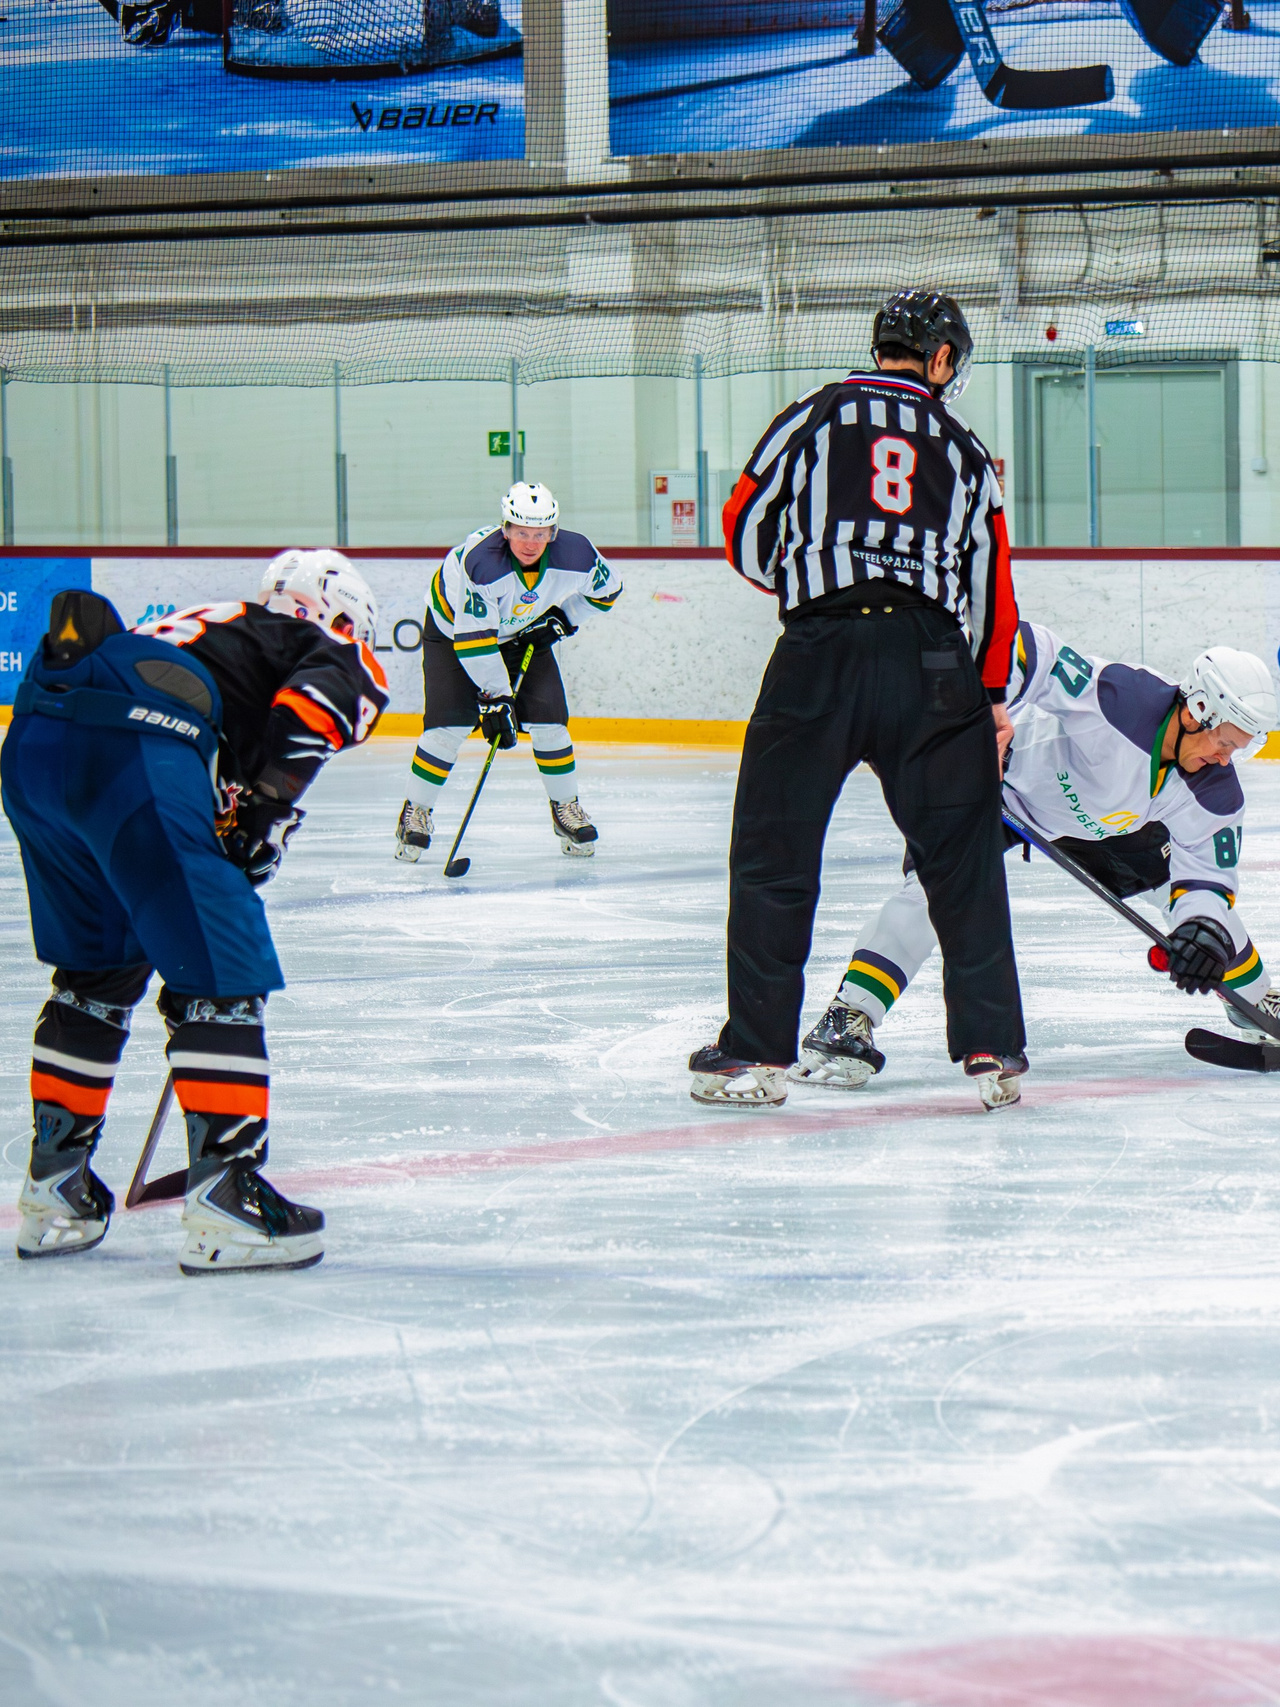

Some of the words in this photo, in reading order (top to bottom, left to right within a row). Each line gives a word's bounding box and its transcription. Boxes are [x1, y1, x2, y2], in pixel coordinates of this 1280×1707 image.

[377, 103, 500, 131] BAUER
[871, 435, 918, 516] 8
[852, 550, 881, 564] STEEL
[893, 557, 923, 571] AXES
[463, 587, 488, 619] 26
[1050, 646, 1093, 698] 87
[127, 706, 201, 741] BAUER
